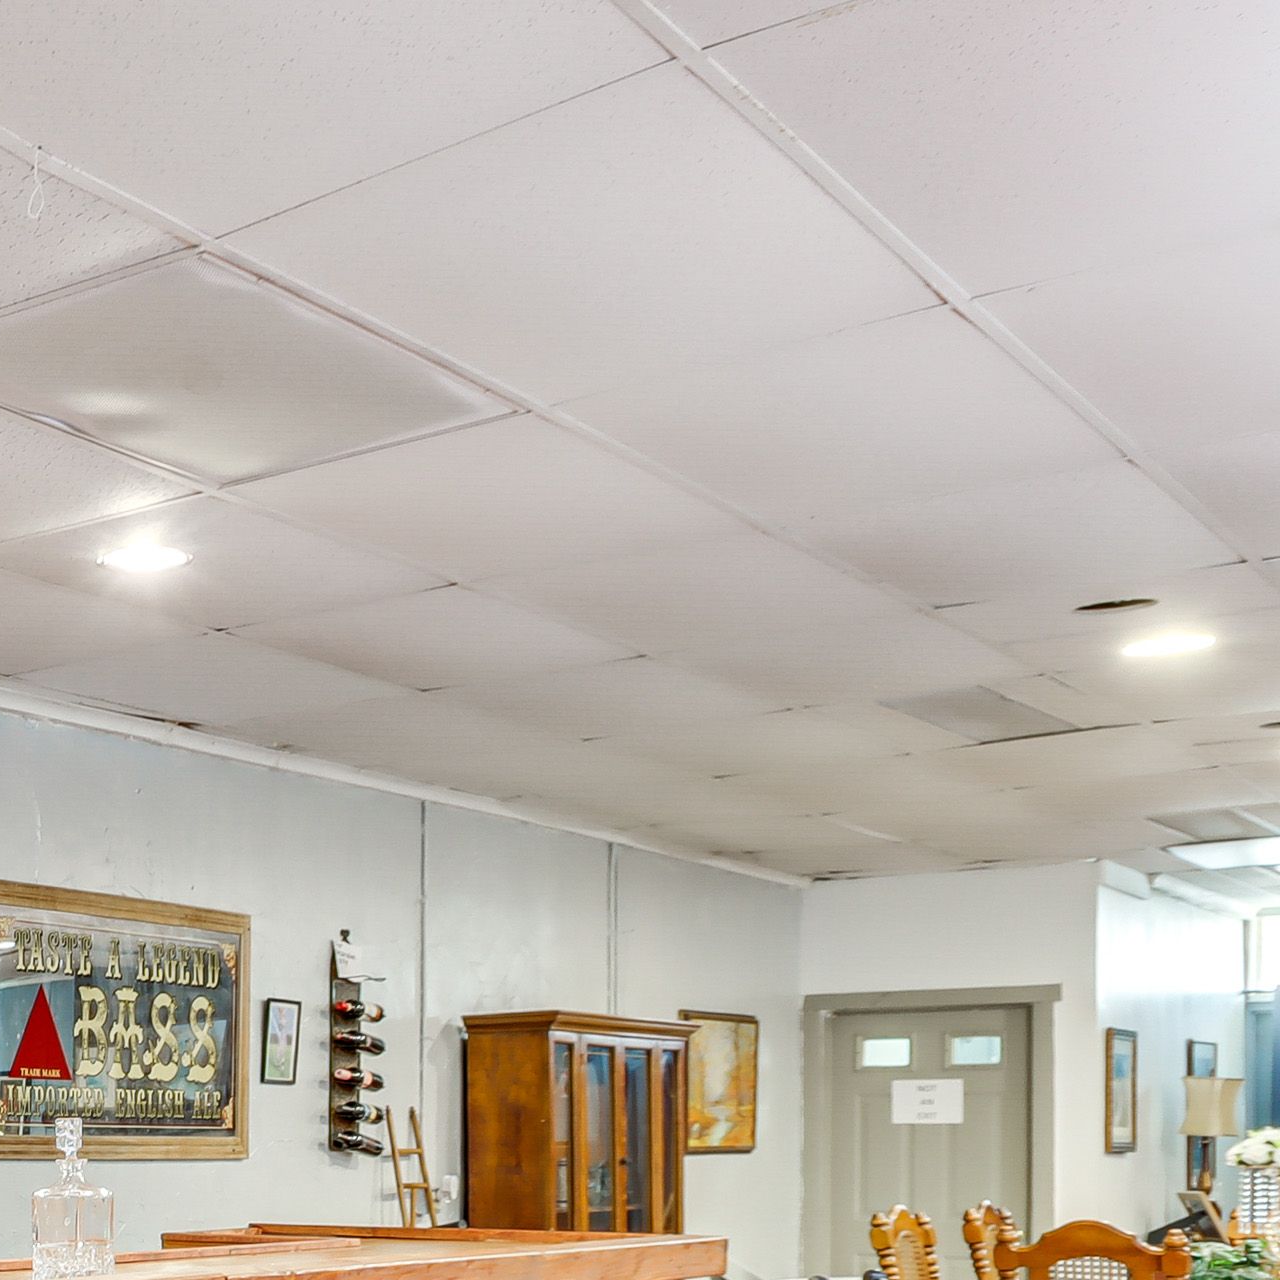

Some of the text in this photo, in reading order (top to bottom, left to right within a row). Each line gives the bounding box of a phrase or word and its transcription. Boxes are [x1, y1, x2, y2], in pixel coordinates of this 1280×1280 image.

[14, 927, 220, 989] TASTE A LEGEND
[74, 984, 217, 1084] BASS
[7, 1084, 222, 1119] IMPORTED ENGLISH ALE
